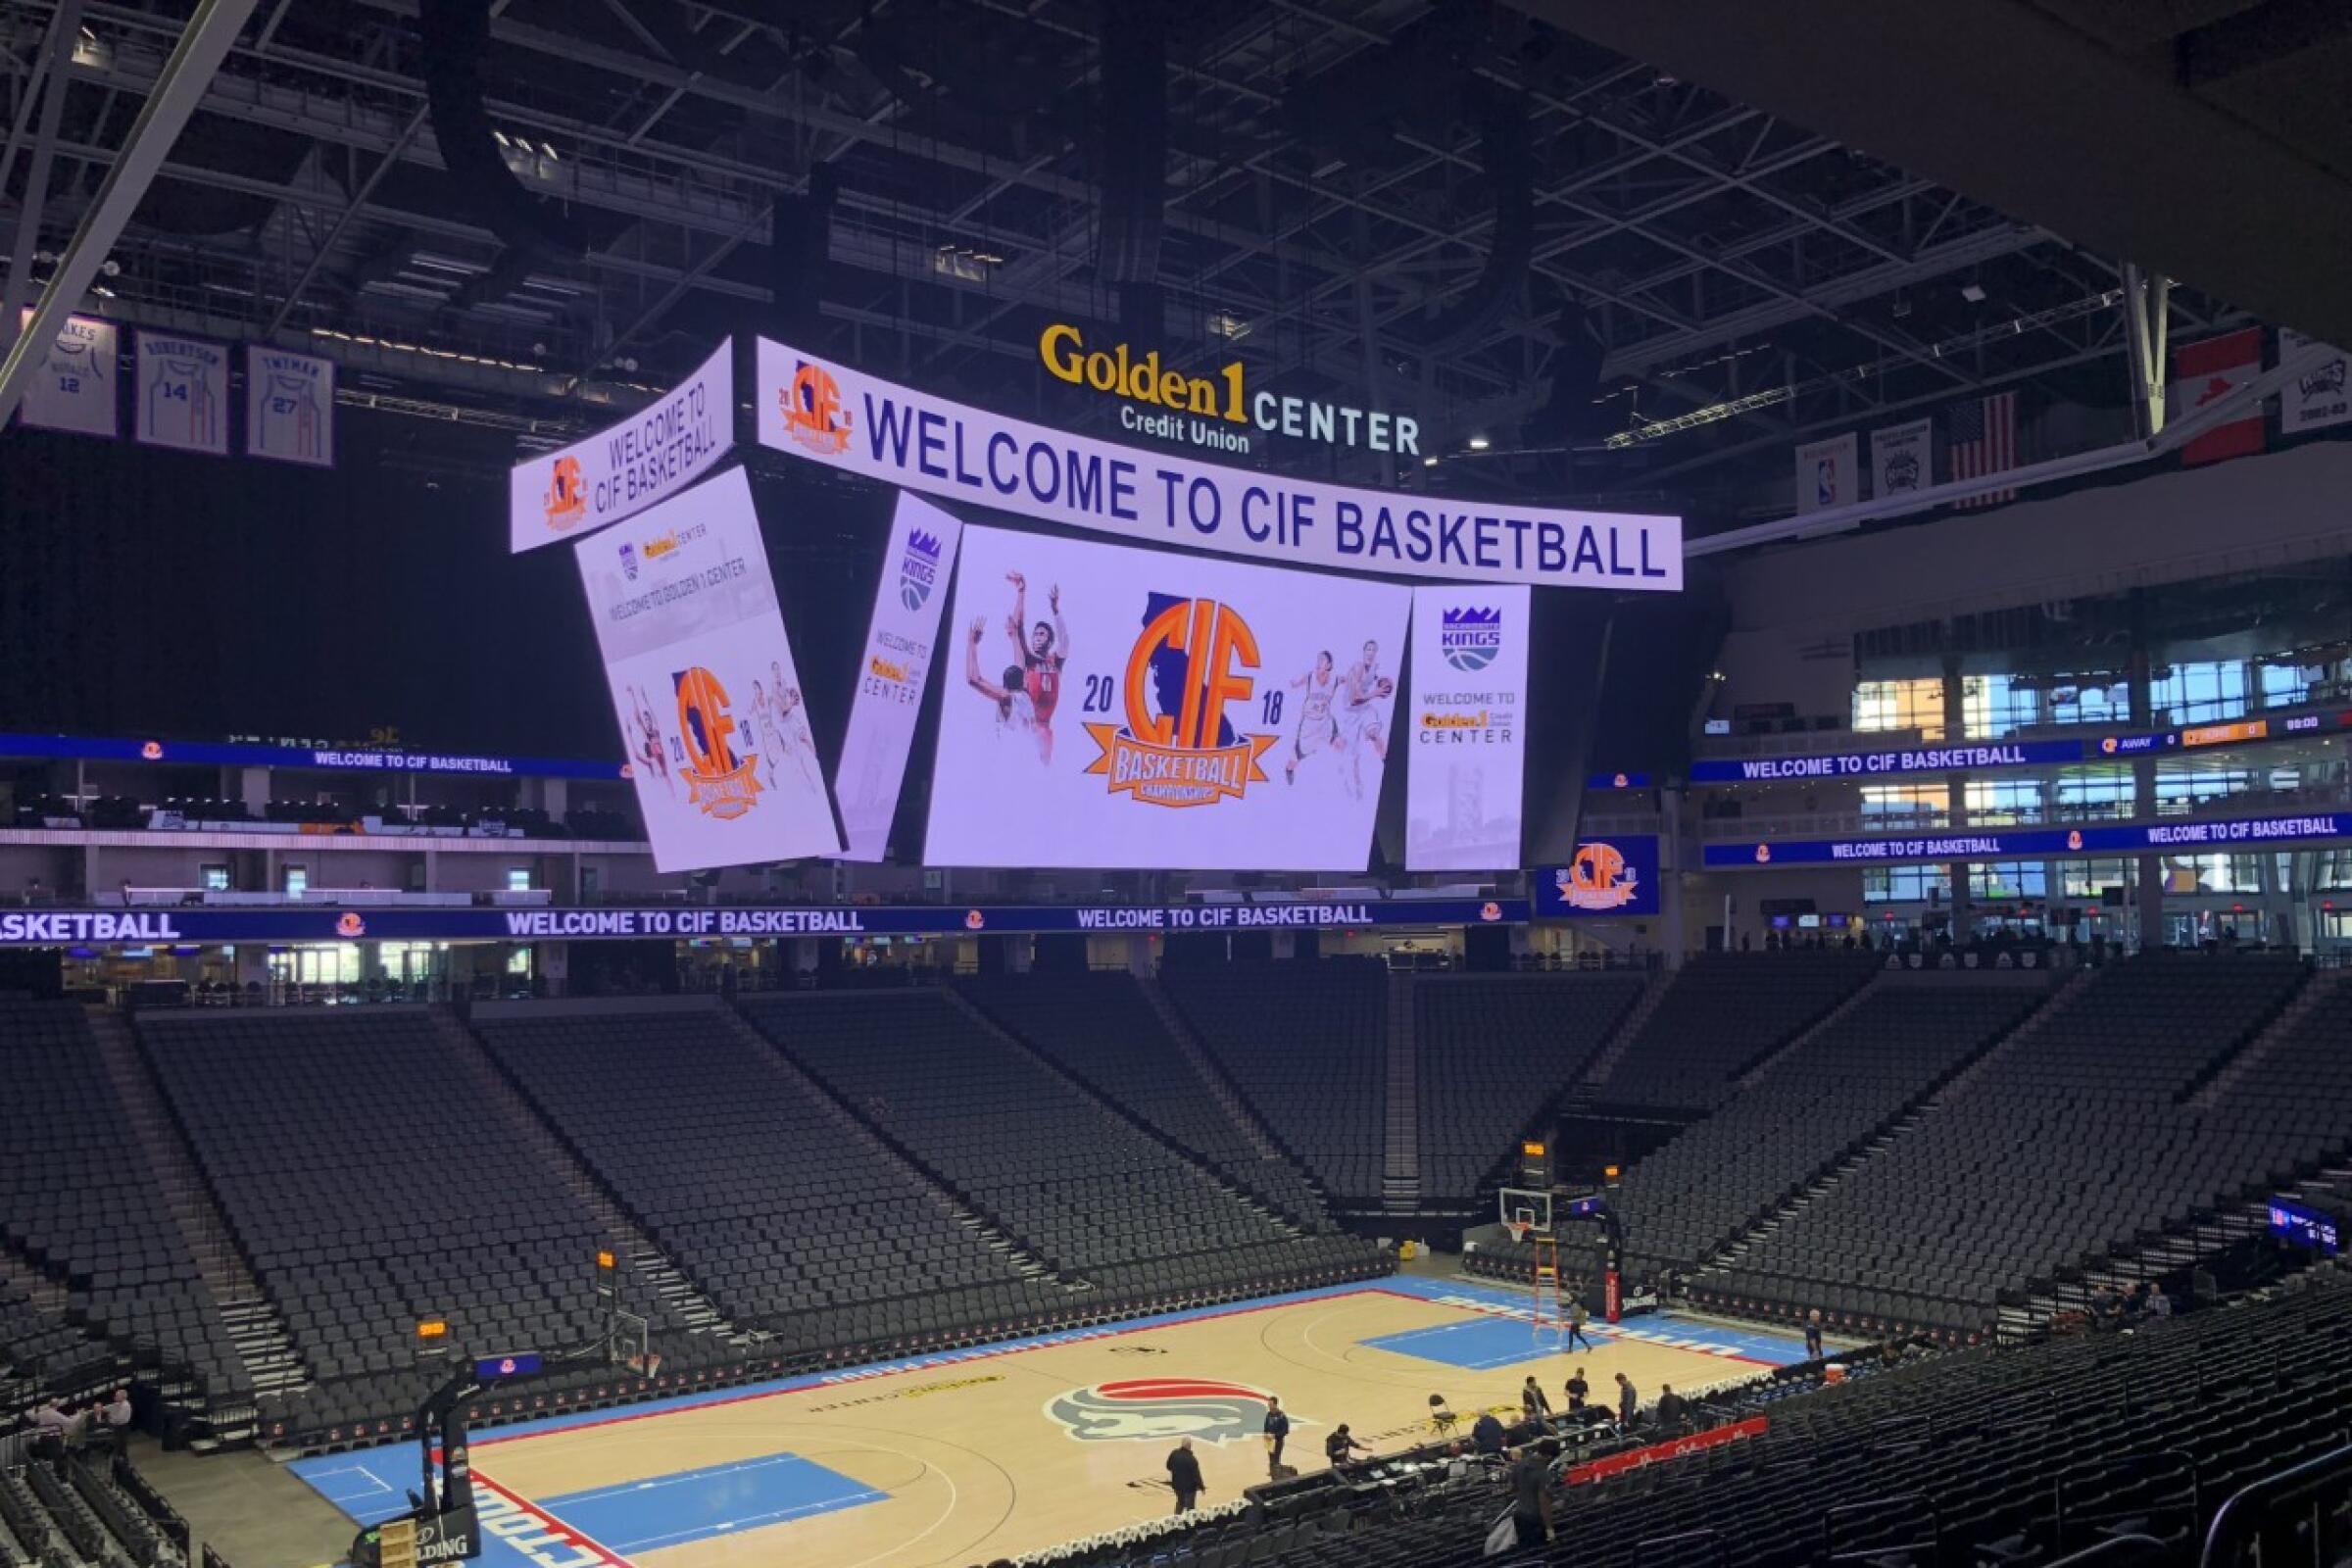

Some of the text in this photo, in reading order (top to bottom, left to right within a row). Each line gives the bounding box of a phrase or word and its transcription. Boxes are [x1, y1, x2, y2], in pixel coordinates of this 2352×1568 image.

[61, 377, 79, 393] 12
[164, 381, 188, 401] 14
[272, 396, 297, 414] 27
[610, 381, 705, 470] WELCOME TO
[1121, 405, 1250, 454] Credit Union
[1254, 392, 1420, 456] CENTER
[595, 415, 715, 514] CIF BASKETBALL
[863, 393, 1666, 578] WELCOME TO CIF BASKETBALL
[902, 558, 937, 585] KINGS
[1443, 632, 1499, 646] KINGS
[1083, 597, 1284, 750] 20 CIF 18
[1424, 693, 1514, 705] WELCOME TO
[1420, 730, 1511, 744] CENTER
[2120, 738, 2151, 750] AWAY
[315, 751, 512, 773] WELCOME TO CIF BASKETBALL
[1114, 745, 1241, 788] BASKETBALL
[1743, 746, 2026, 778] WELCOME TO CIF BASKETBALL
[2148, 817, 2337, 843] WELCOME TO CIF BASKETBALL
[1832, 838, 2000, 858] WELCOME TO CIF BASKETBALL
[0, 912, 180, 939] SKETBALL
[506, 910, 864, 934] WELCOME TO CIF BASKETBALL
[1078, 906, 1373, 927] WELCOME TO CIF BASKETBALL
[416, 1536, 467, 1560] LDING
